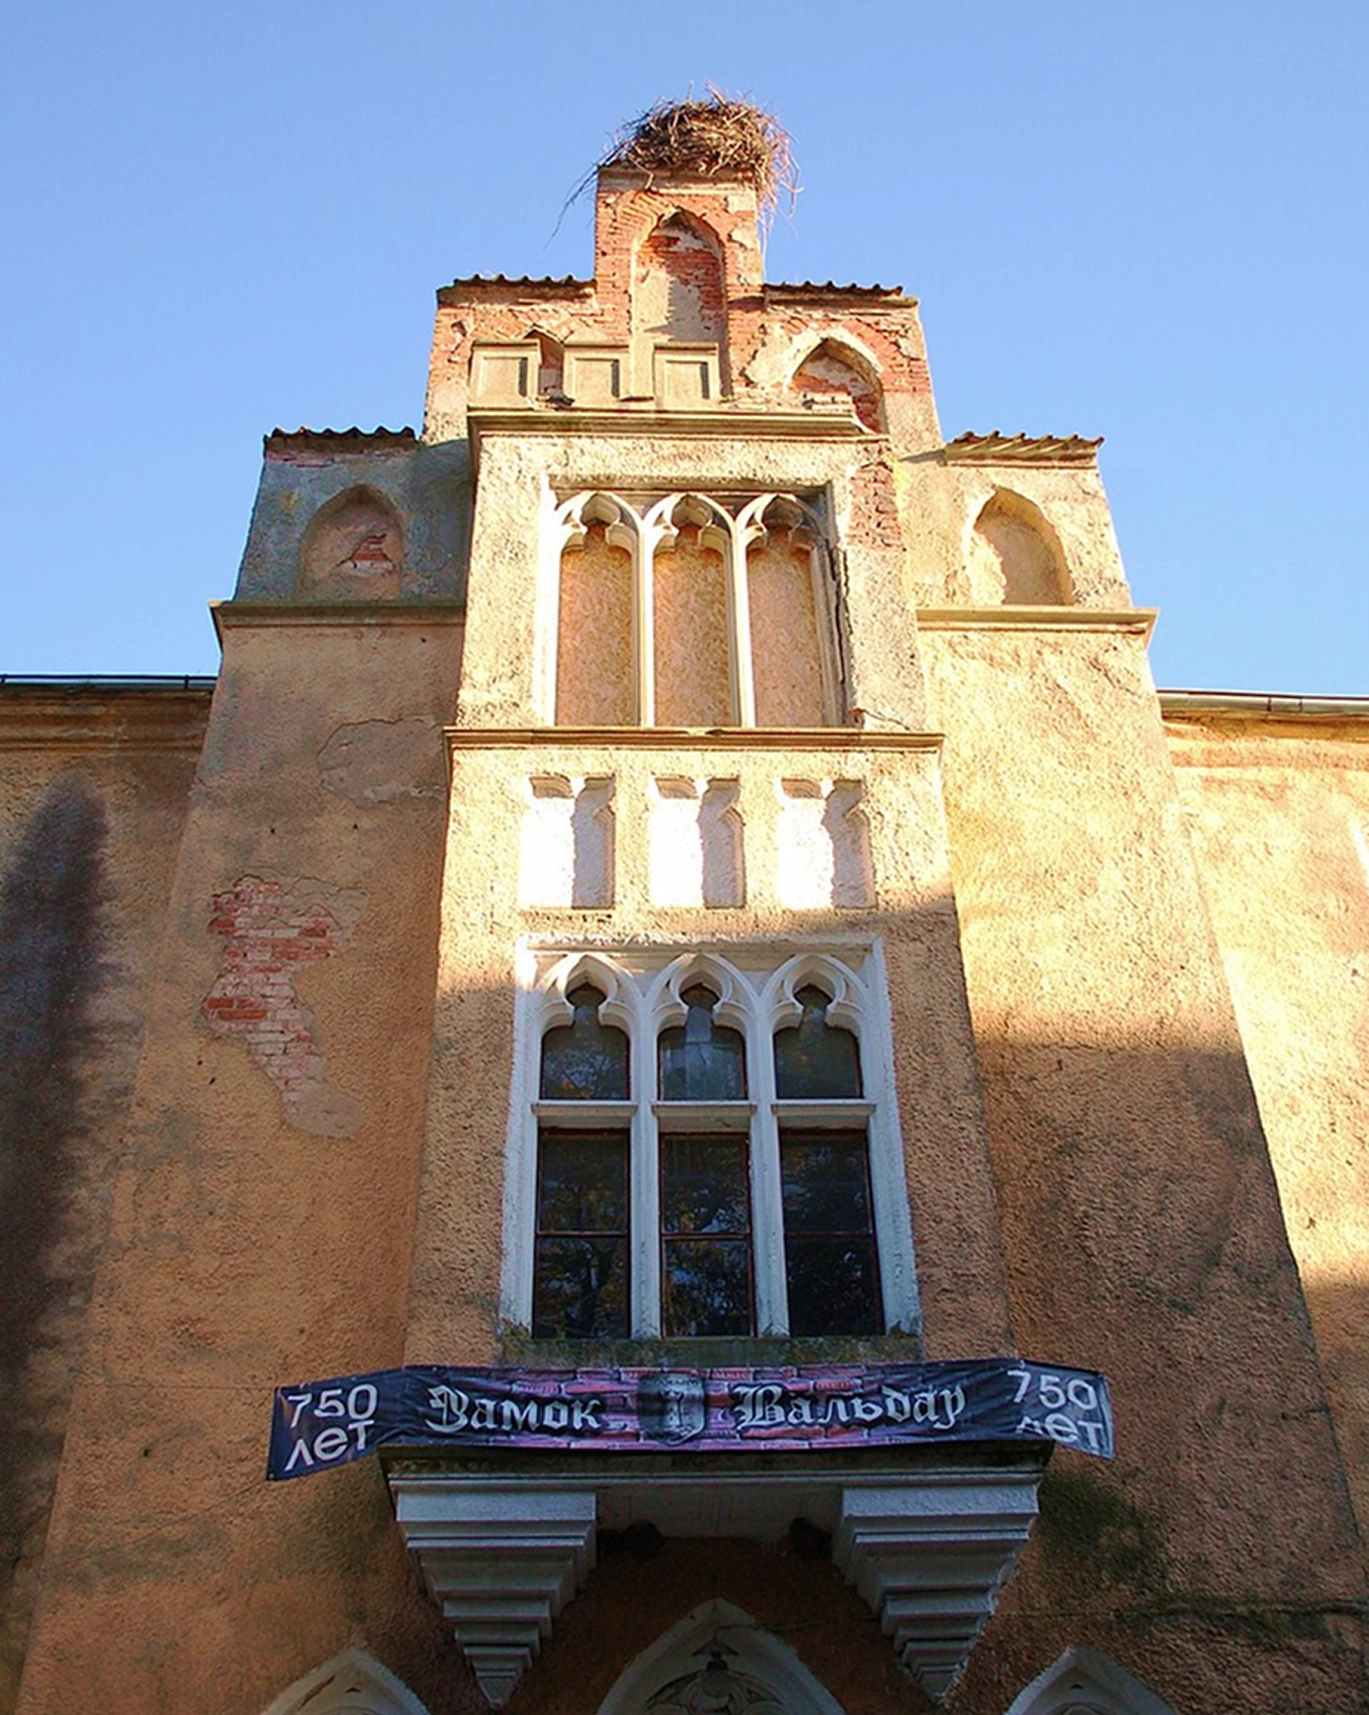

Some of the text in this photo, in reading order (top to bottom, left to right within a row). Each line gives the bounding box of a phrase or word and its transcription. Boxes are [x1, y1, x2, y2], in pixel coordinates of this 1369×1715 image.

[287, 1383, 378, 1428] 750
[425, 1384, 965, 1433] Замок Вальдау
[1007, 1370, 1098, 1410] 750
